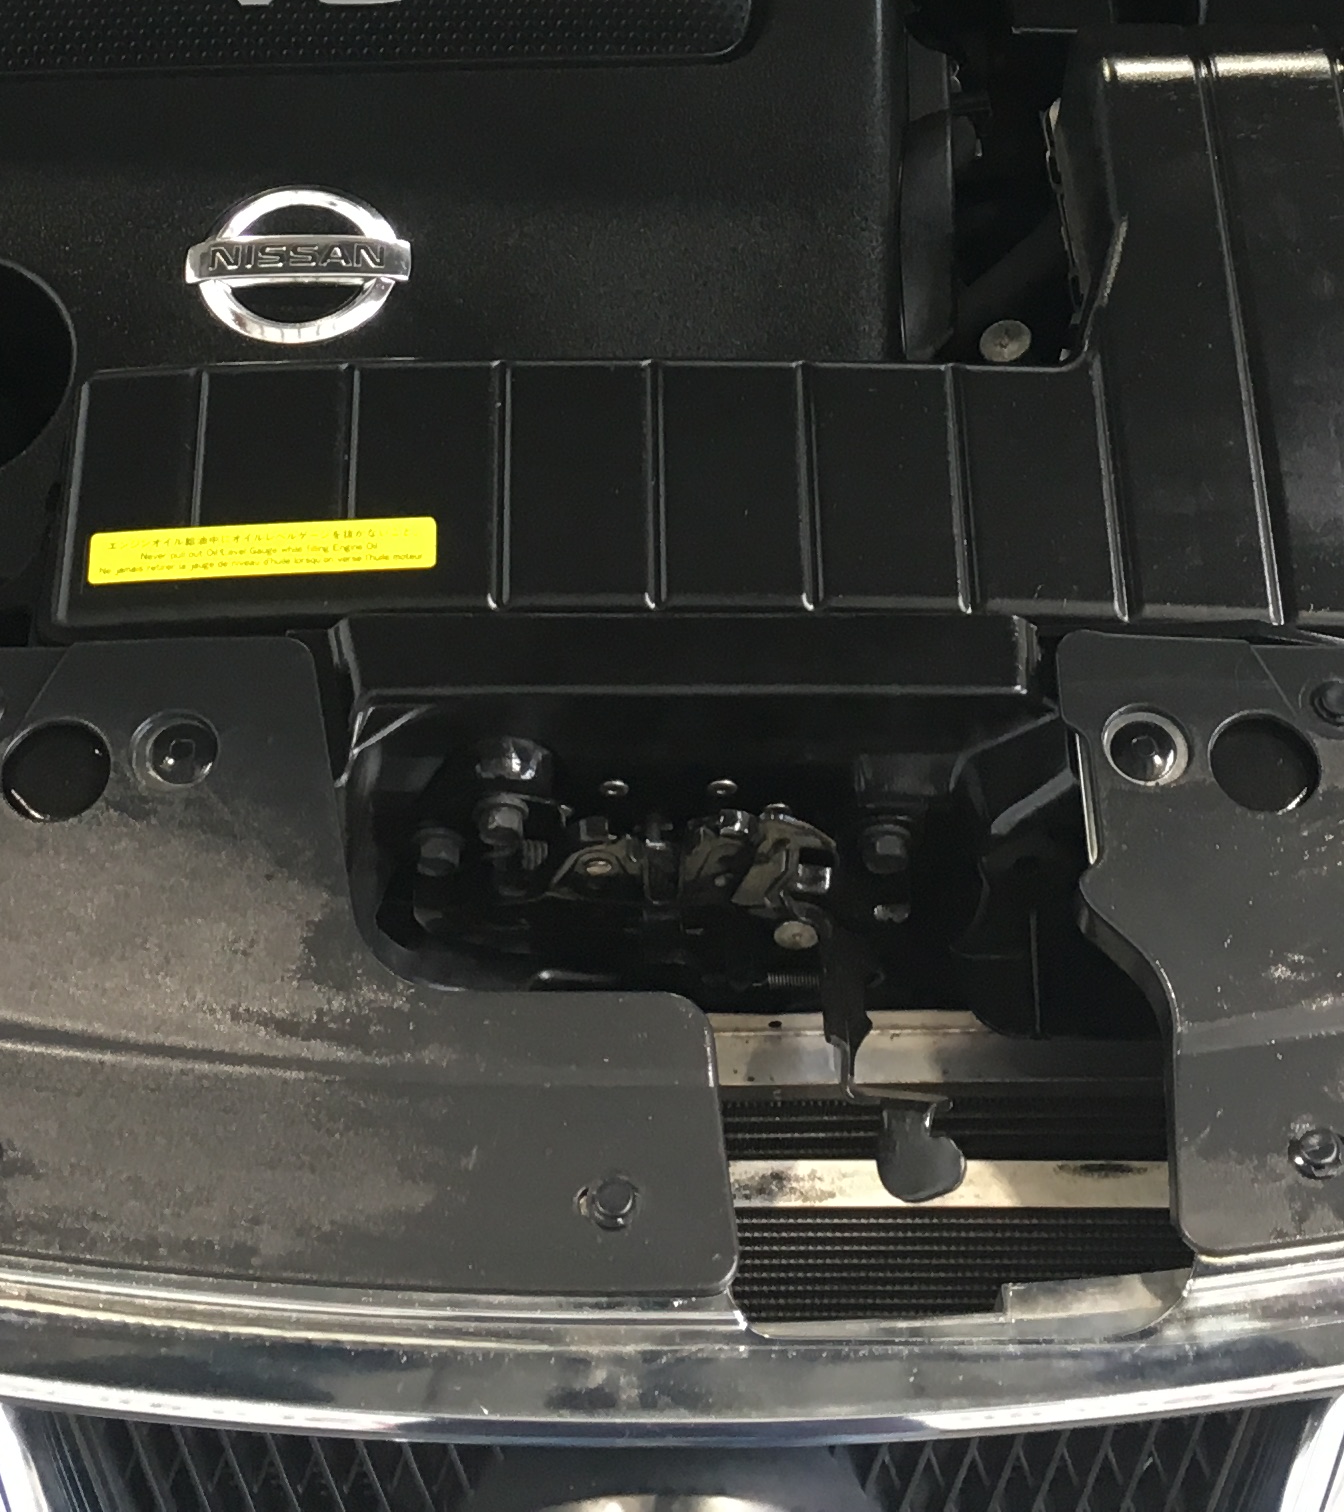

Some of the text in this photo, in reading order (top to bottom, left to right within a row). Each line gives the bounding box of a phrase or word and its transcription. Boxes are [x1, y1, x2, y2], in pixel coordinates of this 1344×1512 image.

[207, 241, 387, 273] NISSAN
[140, 551, 166, 561] Never
[188, 549, 203, 559] out
[249, 546, 278, 556] Gauge
[332, 543, 363, 553] Engine
